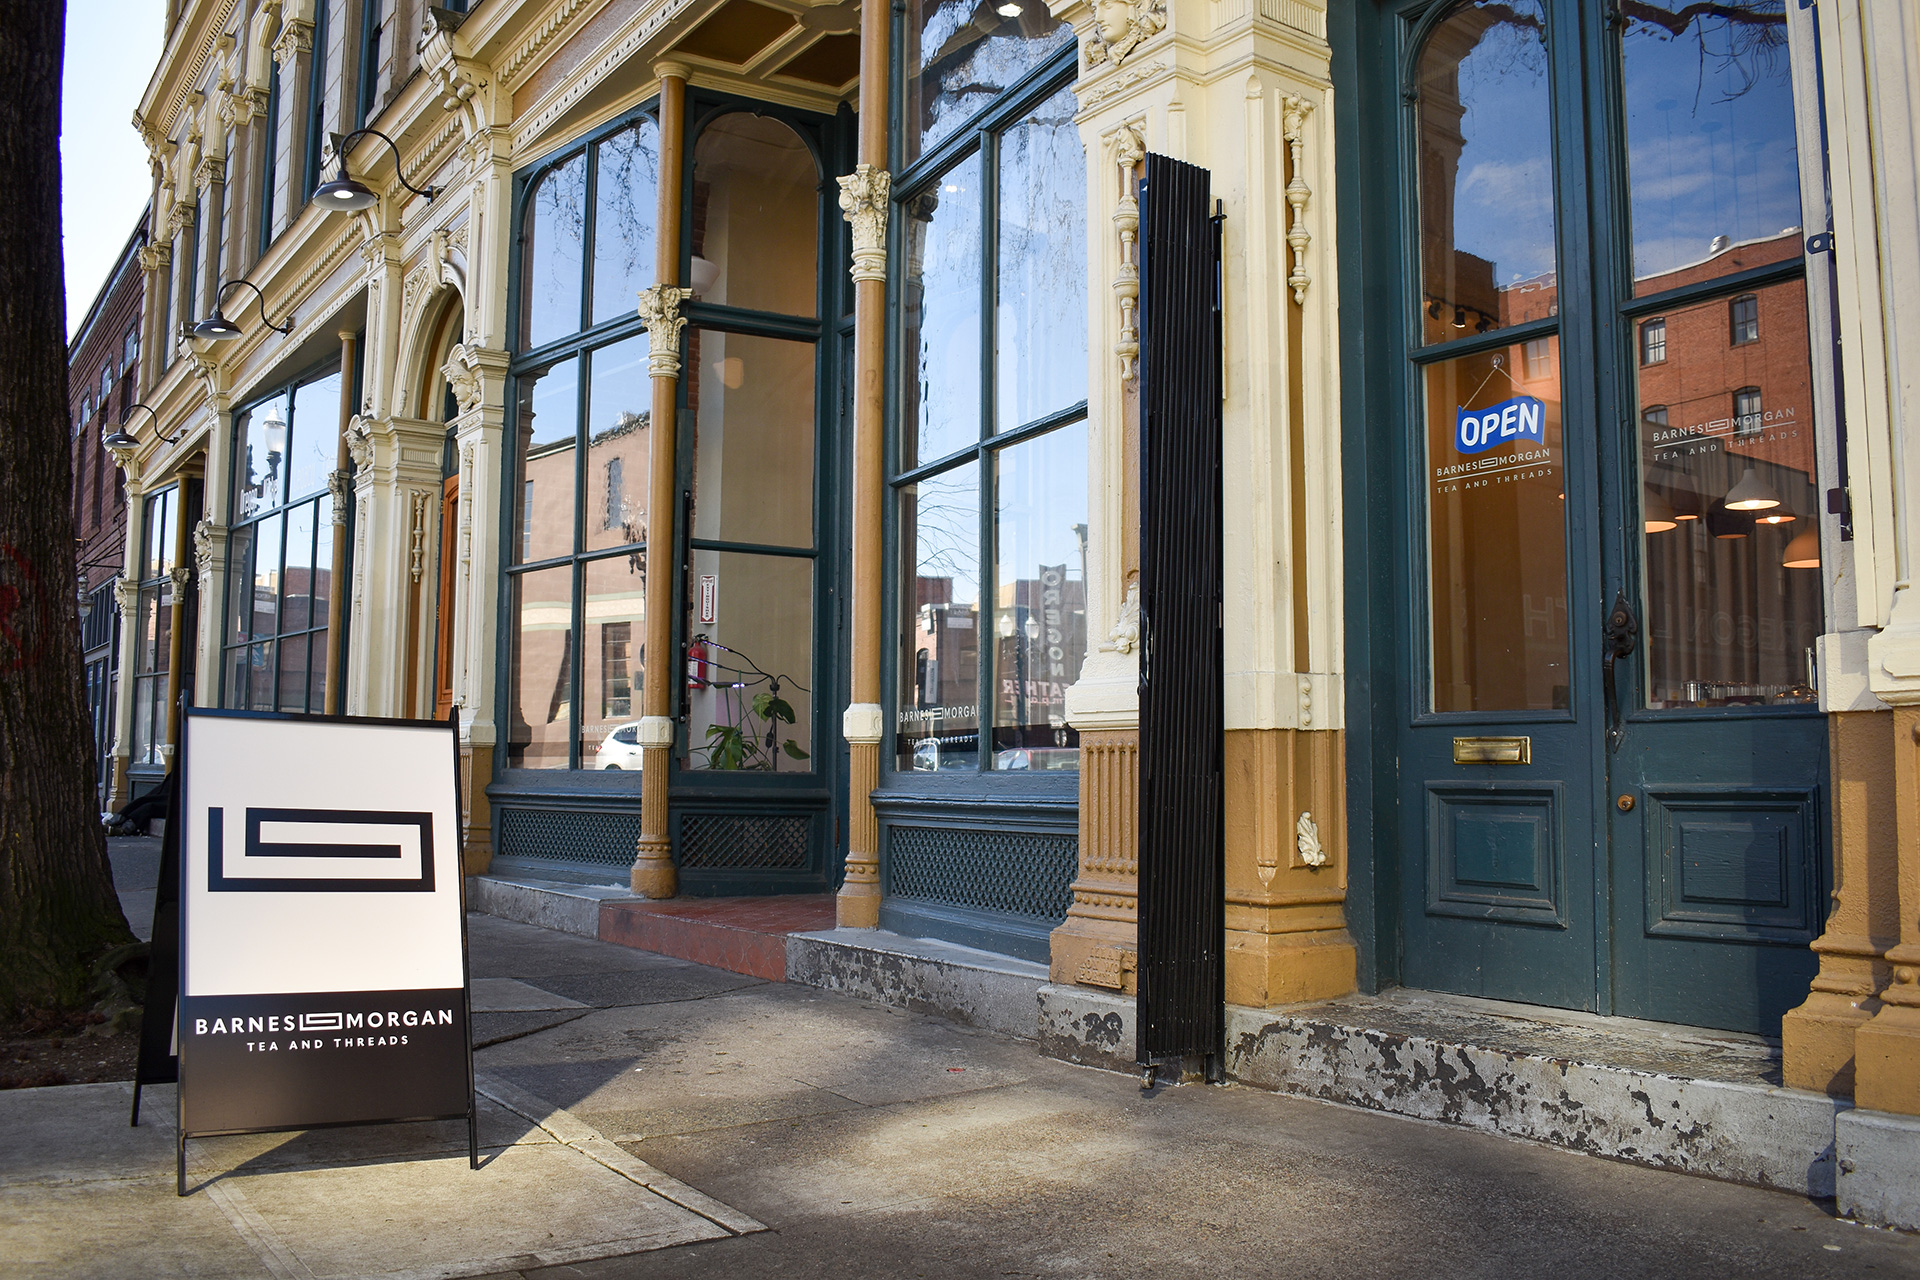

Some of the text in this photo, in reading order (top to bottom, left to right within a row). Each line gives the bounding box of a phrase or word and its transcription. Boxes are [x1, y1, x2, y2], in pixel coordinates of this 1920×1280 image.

[1461, 402, 1539, 447] OPEN
[1653, 407, 1795, 442] BARNES MORGAN
[1654, 430, 1798, 462] TEA AND THREADS
[1437, 448, 1550, 477] BARNES MORGAN
[1437, 469, 1552, 494] TEA AND THREADS
[581, 724, 608, 734] BARNES
[900, 710, 929, 723] BARNES
[940, 735, 973, 744] THREADS
[195, 1009, 453, 1035] BARNES MORGAN
[246, 1035, 410, 1052] TEA AND THREADS
